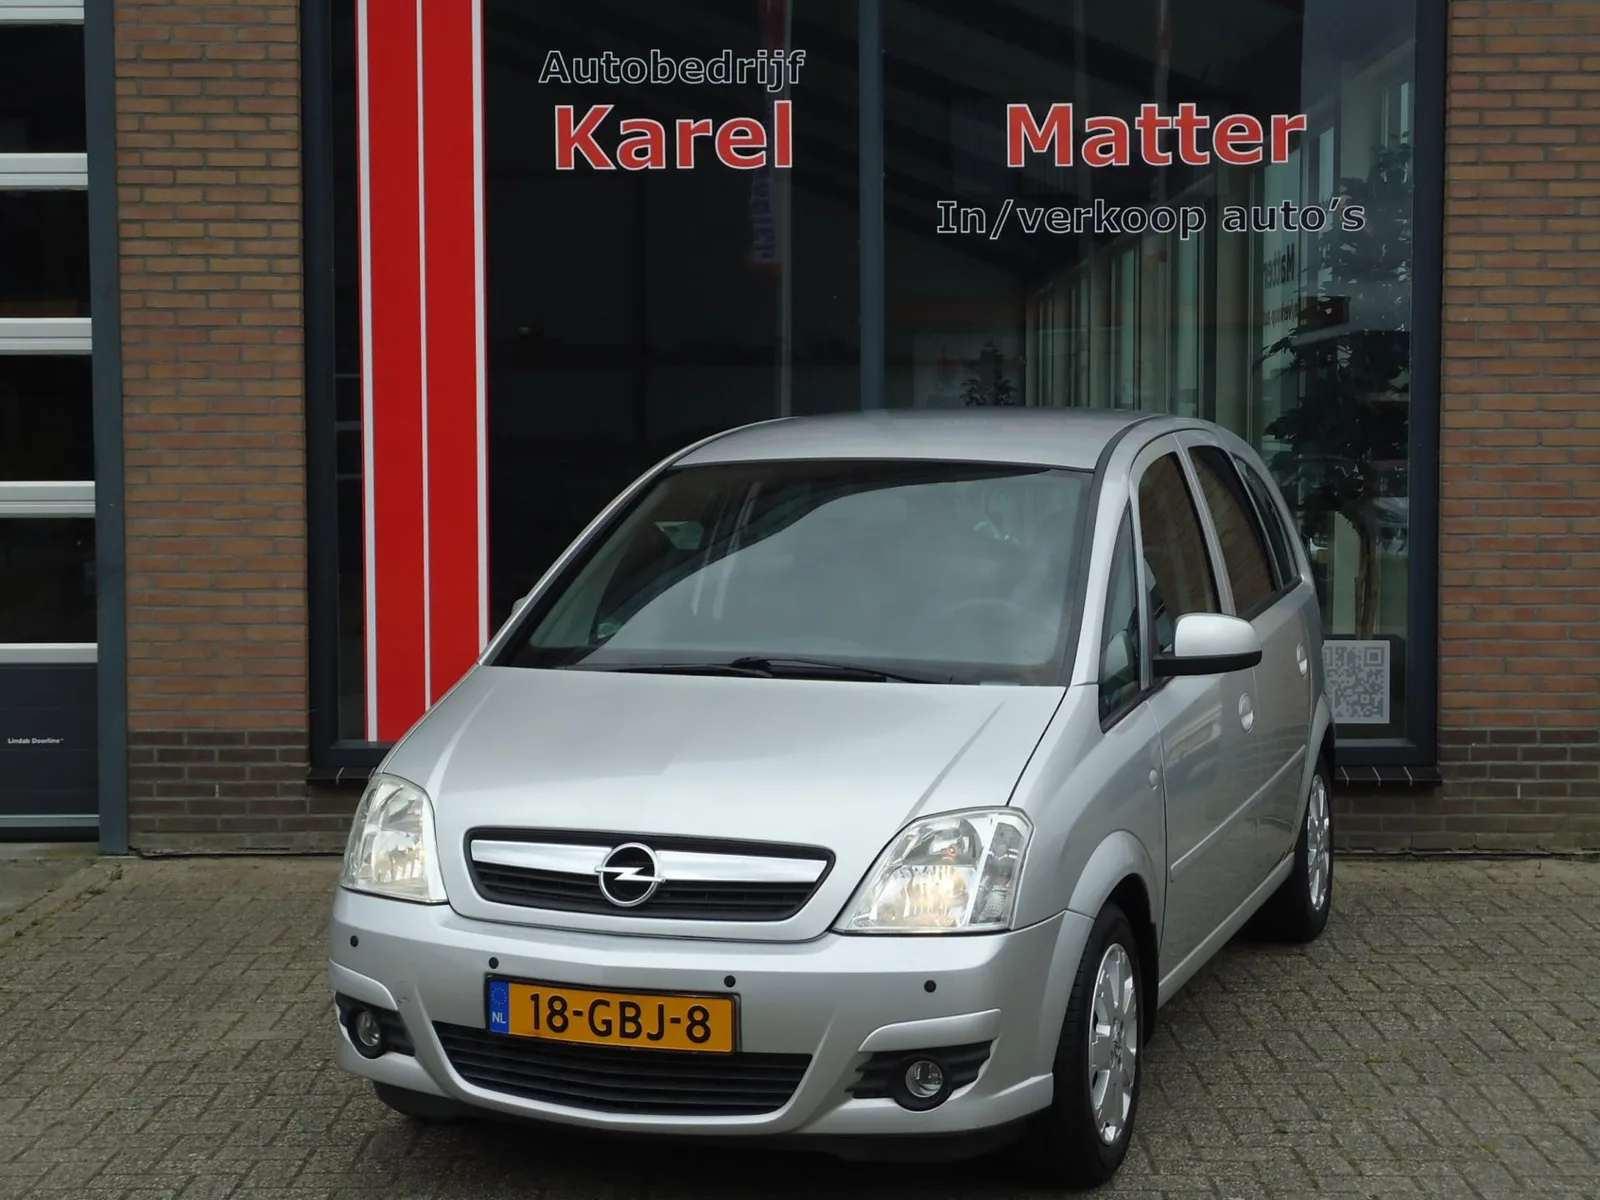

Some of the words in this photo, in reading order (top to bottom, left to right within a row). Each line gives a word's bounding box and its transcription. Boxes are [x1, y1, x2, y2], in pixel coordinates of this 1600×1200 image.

[538, 49, 806, 92] Autobedrijf
[555, 100, 793, 170] Karel
[1006, 103, 1307, 168] Matter
[936, 199, 1206, 240] In/verkoop
[1222, 197, 1365, 232] auto's
[492, 1011, 506, 1024] NL
[530, 993, 711, 1044] 18-GBJ-8
